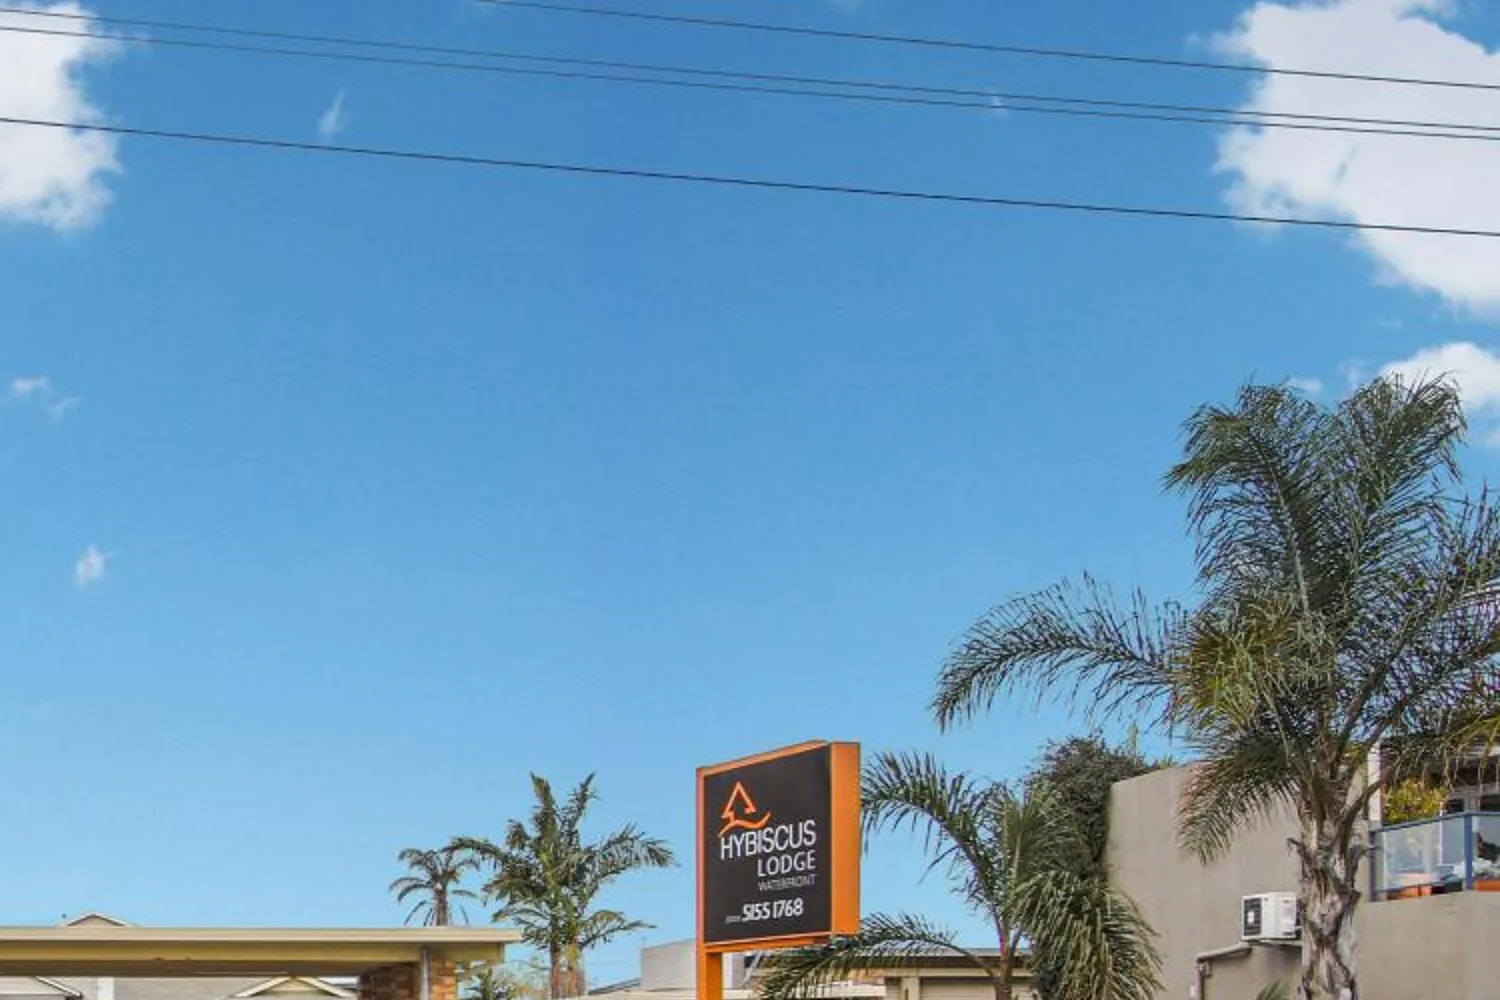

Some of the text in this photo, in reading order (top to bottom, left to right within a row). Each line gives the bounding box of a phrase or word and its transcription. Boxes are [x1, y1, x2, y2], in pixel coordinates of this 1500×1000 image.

[720, 819, 817, 860] HYBISCUS
[757, 849, 817, 877] LODGE
[757, 873, 818, 891] WATERFRONT
[772, 897, 804, 919] 1768
